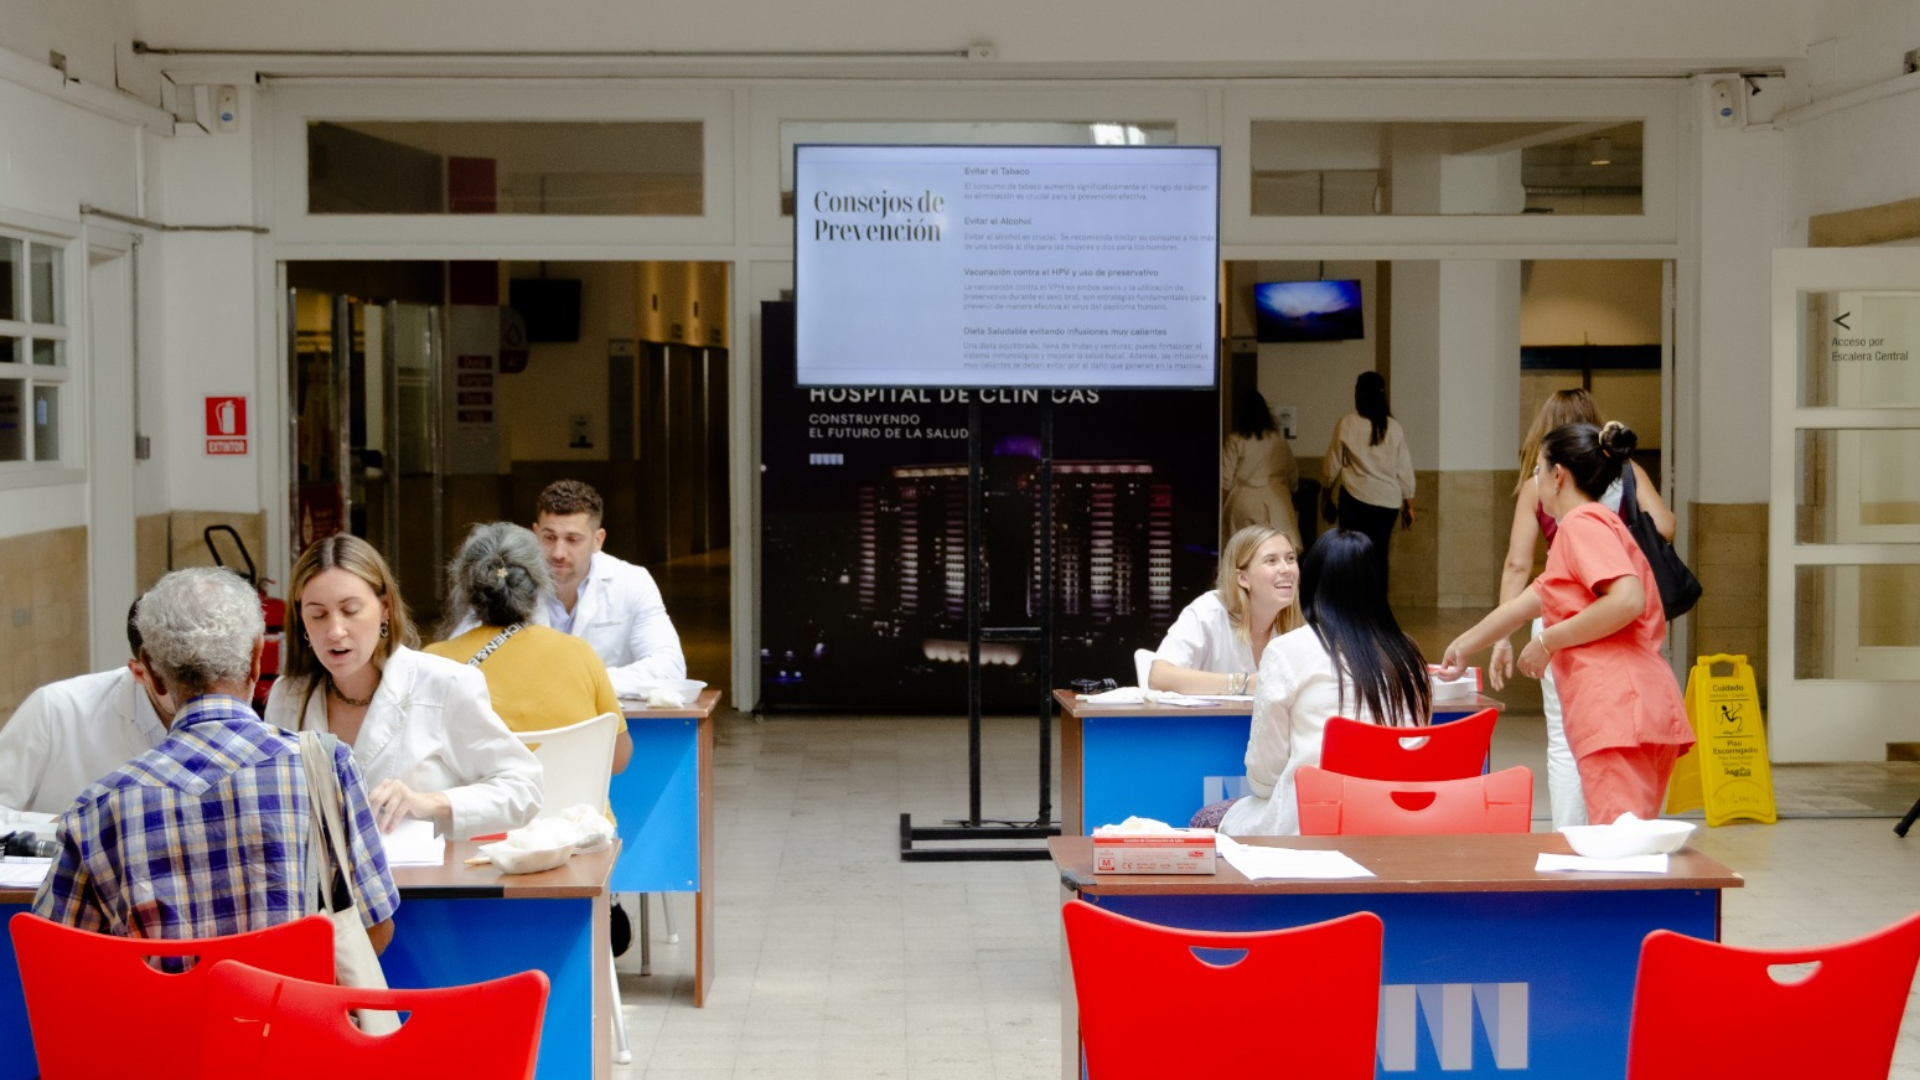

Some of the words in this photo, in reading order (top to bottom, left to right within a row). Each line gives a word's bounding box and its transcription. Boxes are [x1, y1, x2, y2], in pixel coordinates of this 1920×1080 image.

[964, 167, 988, 175] Evitar
[990, 167, 998, 175] el
[1000, 167, 1029, 176] Tabaco
[814, 190, 913, 219] Consejos
[918, 190, 944, 213] de
[964, 216, 989, 225] Evitar
[990, 217, 998, 225] el
[1000, 217, 1032, 225] Alcohol
[815, 218, 941, 241] Prevención
[964, 267, 1011, 276] Vacunación
[1012, 268, 1040, 276] contra
[1042, 268, 1049, 276] el
[1052, 268, 1069, 276] HPV
[1072, 269, 1076, 278] y
[1095, 268, 1106, 276] de
[1108, 268, 1159, 278] preservativo
[964, 327, 985, 335] Dieta
[987, 327, 1027, 335] Saludable
[1030, 327, 1065, 336] evitando
[1066, 328, 1108, 336] infusiones
[1110, 329, 1128, 337] muy
[1832, 337, 1866, 346] Acceso
[1869, 338, 1884, 347] por
[1832, 352, 1872, 361] Escalera
[1875, 351, 1908, 361] Central
[810, 388, 931, 403] HOSPITAL
[940, 388, 969, 403] DE
[809, 414, 920, 424] CONSTRUYENDO
[809, 428, 825, 438] EL
[828, 428, 880, 438] FUTURO
[885, 428, 904, 438] DE
[906, 428, 923, 438] LA
[926, 428, 969, 439] SALUD
[208, 441, 244, 452] EXTINTOR
